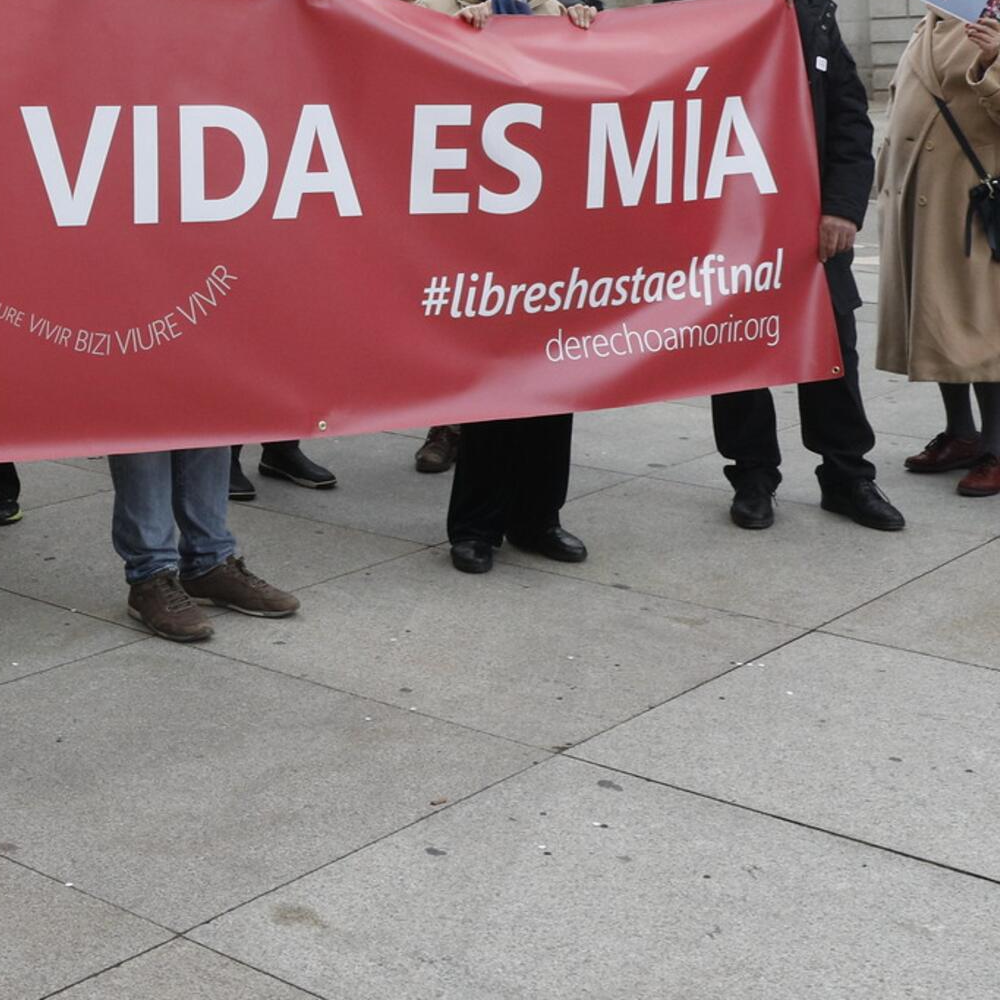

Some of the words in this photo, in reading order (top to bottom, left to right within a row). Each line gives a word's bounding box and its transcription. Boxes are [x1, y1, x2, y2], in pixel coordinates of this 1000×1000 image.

[20, 104, 363, 227] VIDA
[409, 102, 543, 215] ES
[586, 67, 779, 210] MÍA
[29, 313, 72, 348] VIVIR
[74, 329, 111, 356] BIZI
[115, 312, 183, 355] VIURE
[176, 264, 239, 326] VIVIR
[421, 248, 785, 319] #libreshastaelfinal
[545, 314, 781, 363] derechoamorir.org
